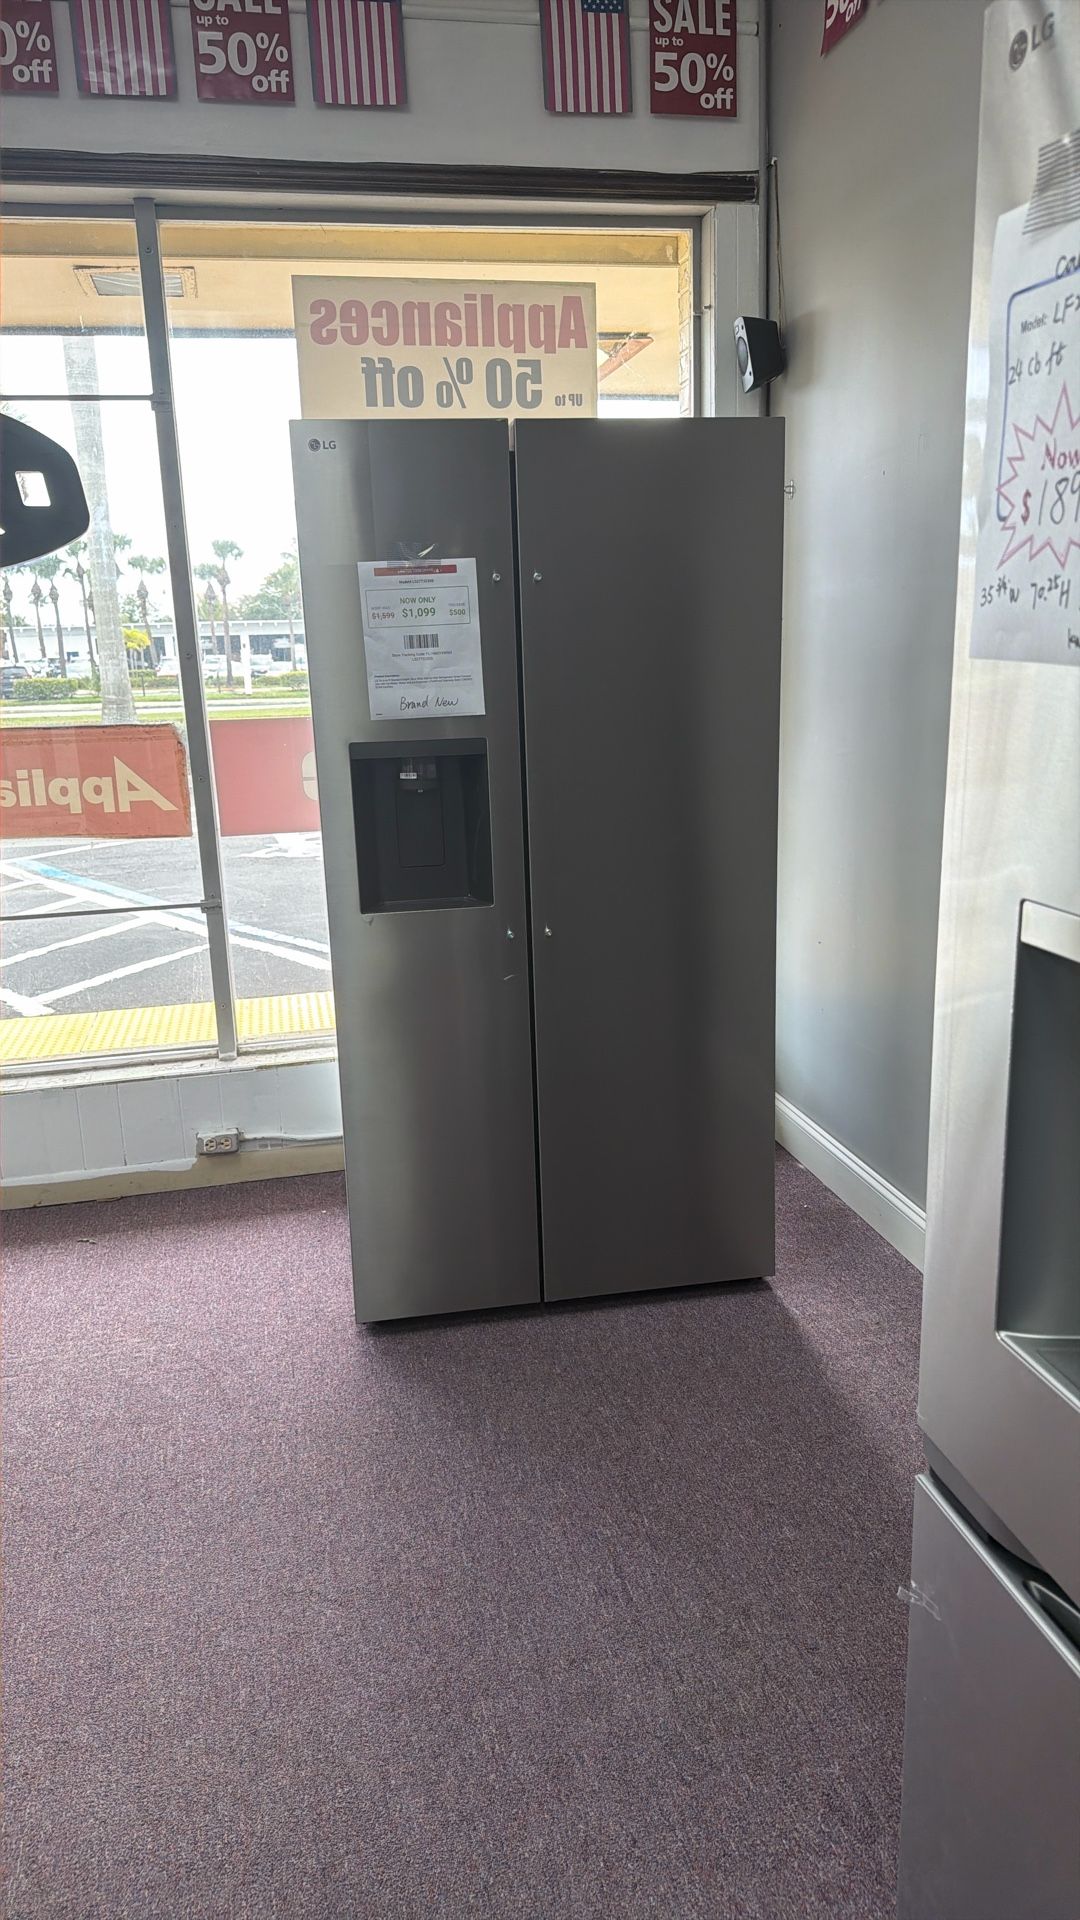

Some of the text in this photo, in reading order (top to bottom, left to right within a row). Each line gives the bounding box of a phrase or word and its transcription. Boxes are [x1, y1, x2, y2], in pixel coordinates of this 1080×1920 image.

[196, 14, 229, 27] up to
[653, 0, 731, 36] SALE
[655, 36, 684, 47] up to
[1031, 12, 1055, 51] LG
[197, 31, 289, 76] 50%
[12, 58, 53, 83] off
[654, 51, 734, 94] 50%
[251, 69, 290, 93] off
[699, 87, 734, 110] off
[322, 440, 337, 450] LG
[400, 596, 436, 605] NOW ONLY
[402, 607, 436, 619] $1,099
[449, 608, 466, 616] $500
[399, 694, 459, 711] Brand New
